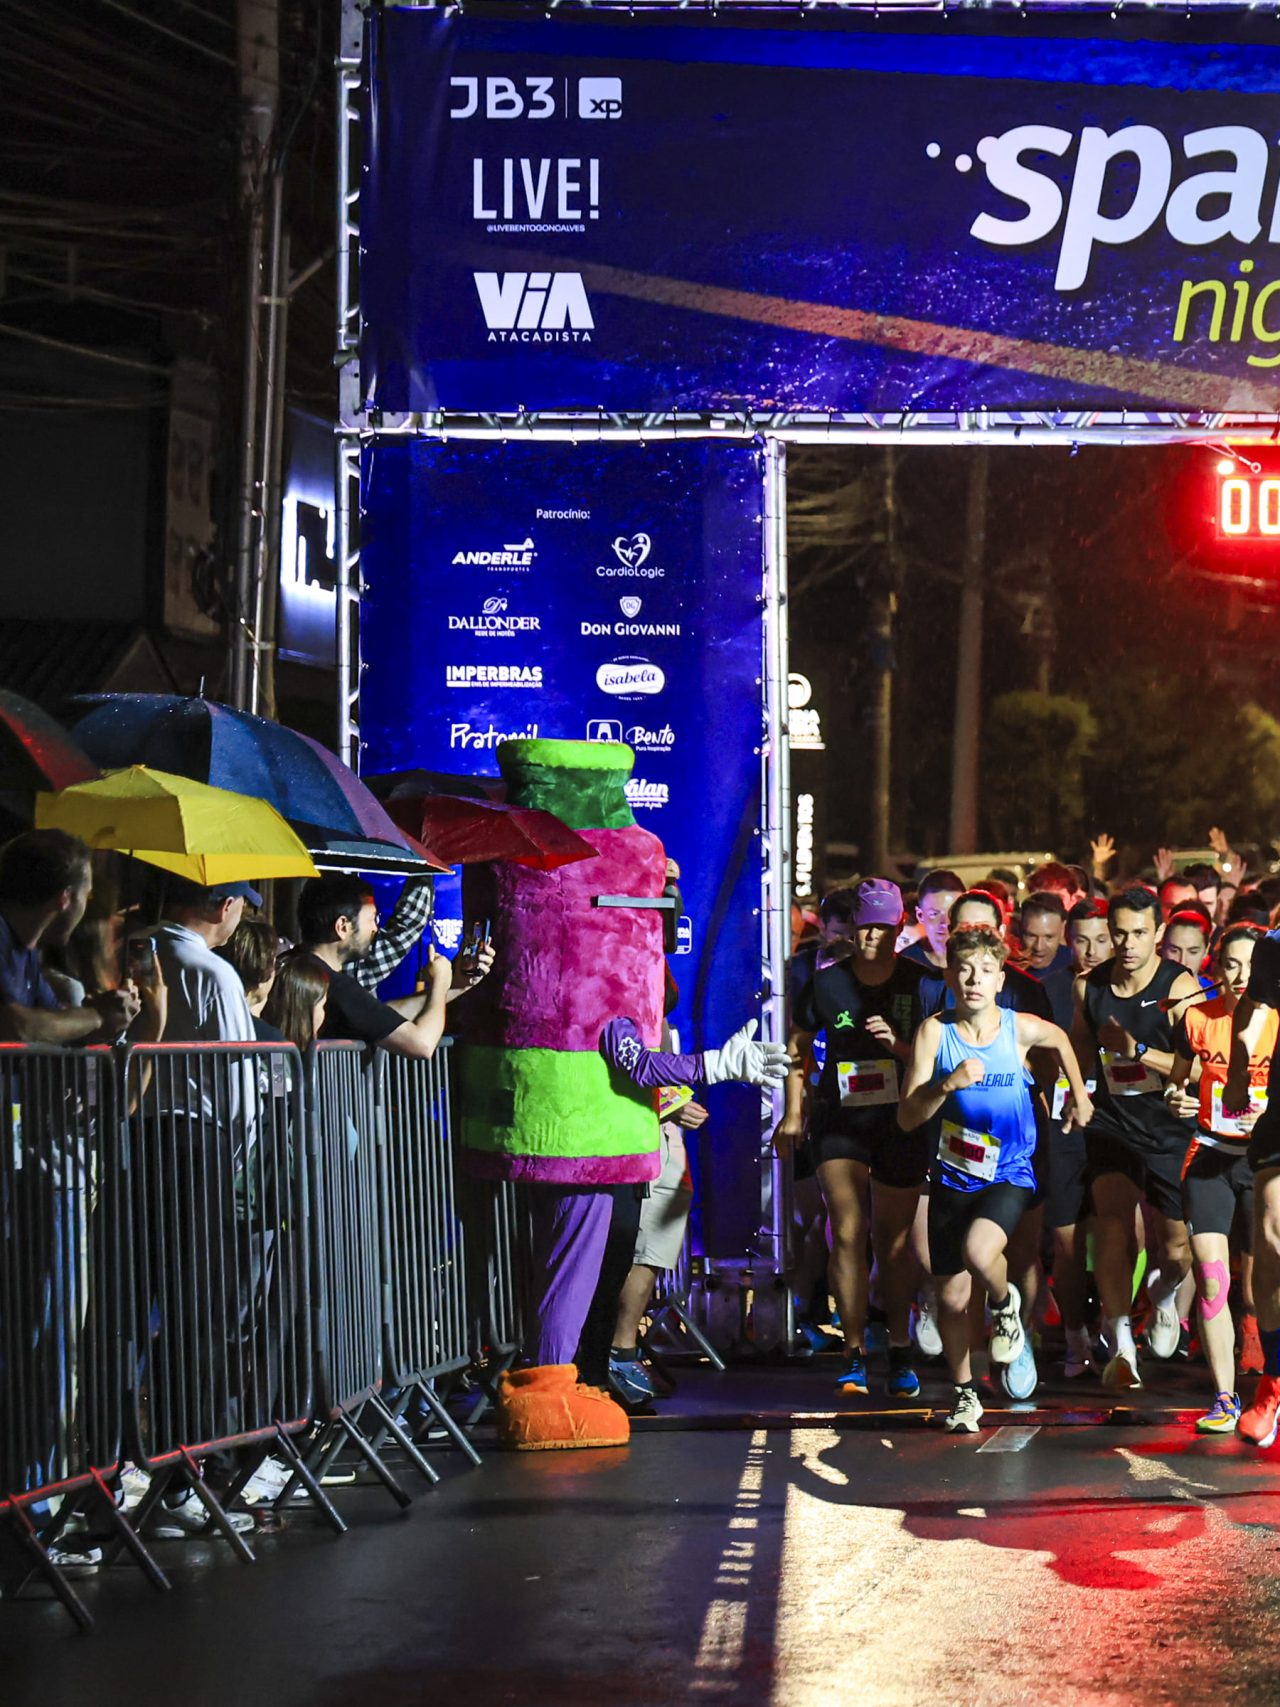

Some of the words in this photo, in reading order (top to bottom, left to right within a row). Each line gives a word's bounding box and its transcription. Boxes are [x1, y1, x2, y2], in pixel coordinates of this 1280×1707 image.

[450, 76, 556, 119] JB3
[473, 158, 600, 220] LIVE!
[488, 331, 592, 342] ATACADISTA
[536, 508, 590, 520] Patrocínio:
[452, 551, 533, 565] ANDERLE
[596, 566, 665, 579] CardioLogic
[581, 622, 611, 635] DON
[614, 622, 681, 636] GIOVANNI
[446, 666, 543, 681] IMPERBRAS
[604, 669, 656, 686] isabela
